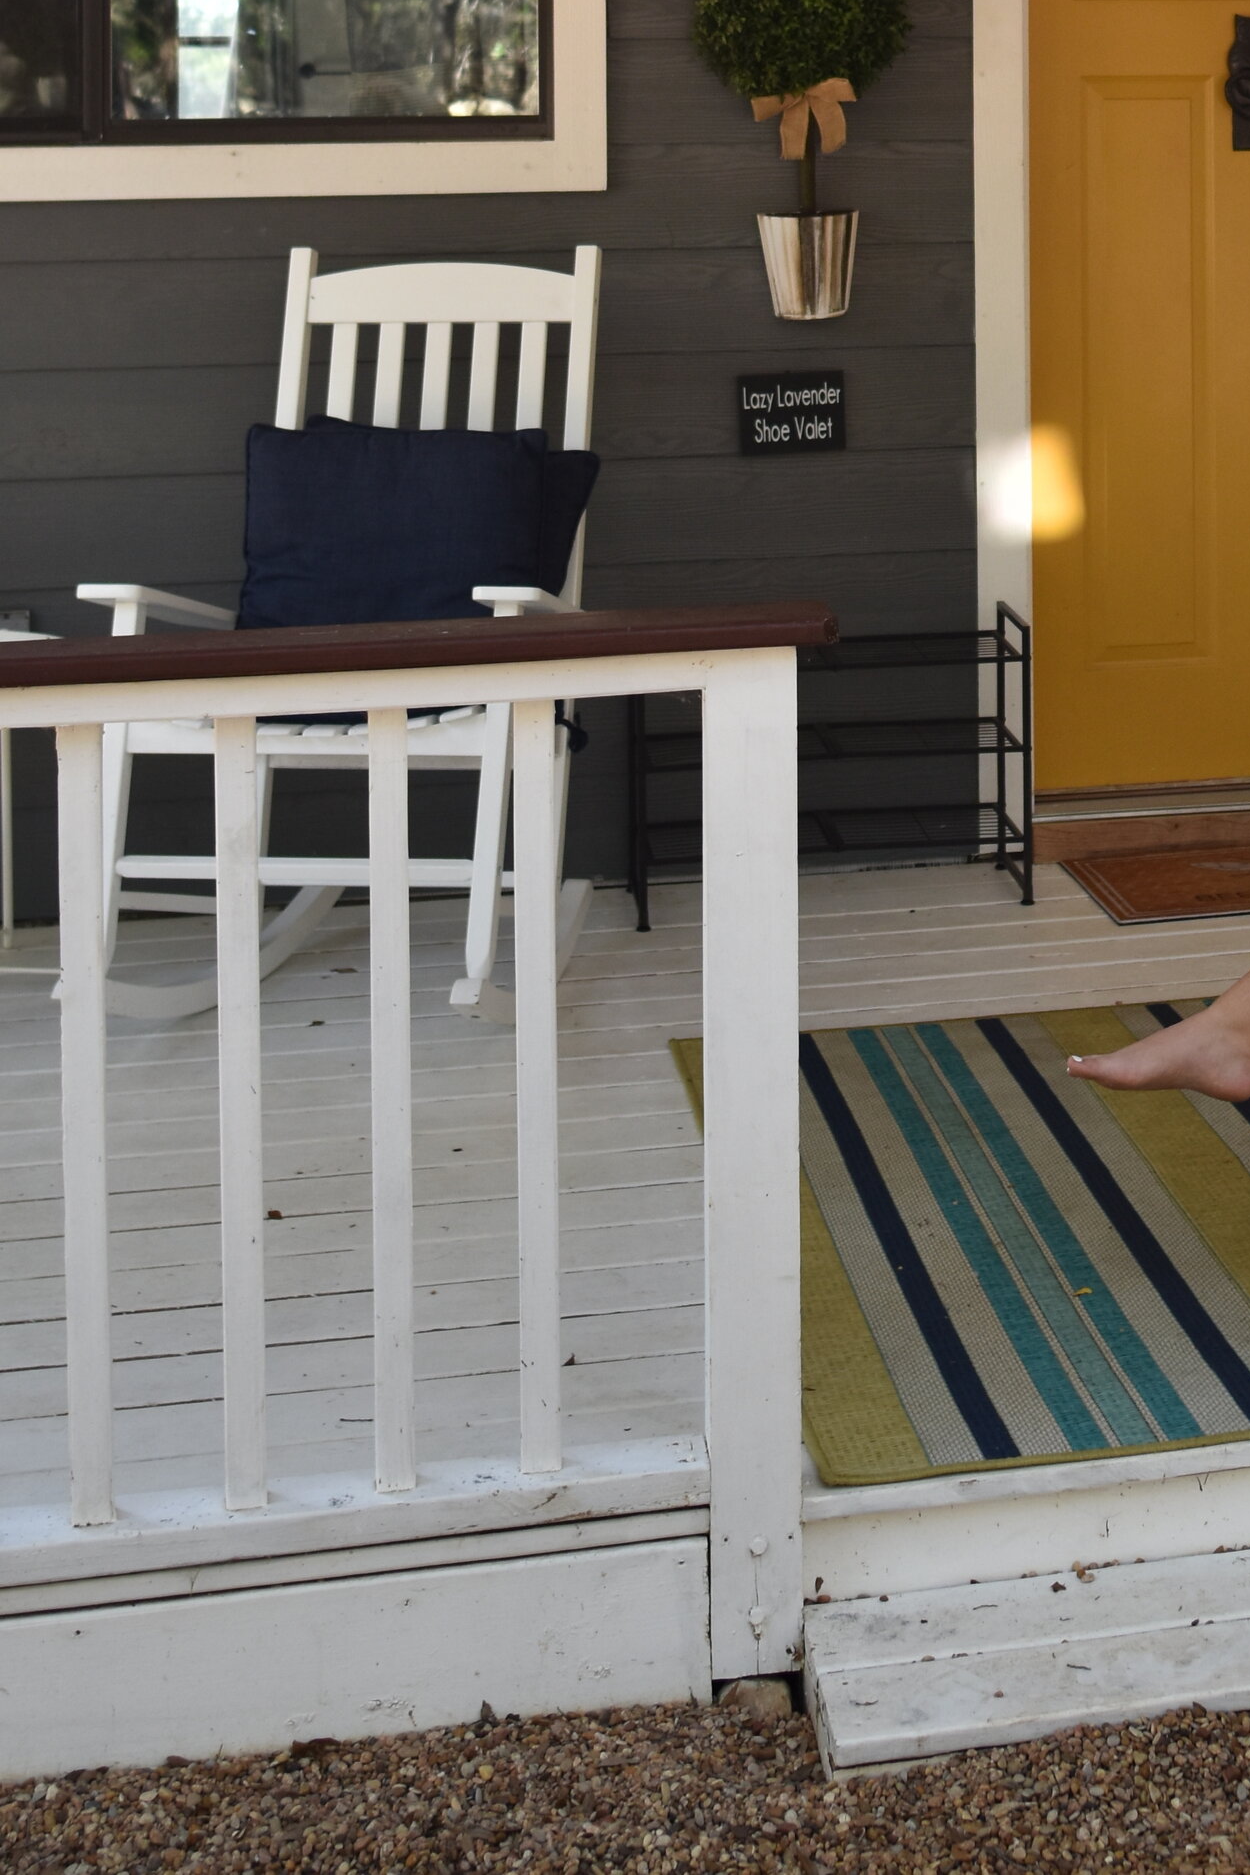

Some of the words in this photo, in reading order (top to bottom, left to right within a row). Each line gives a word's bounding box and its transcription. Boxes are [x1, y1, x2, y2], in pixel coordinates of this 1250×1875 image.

[742, 386, 774, 413] Lazy
[777, 381, 841, 408] Lavender
[754, 418, 791, 444] Shoe
[794, 415, 833, 440] Valet
